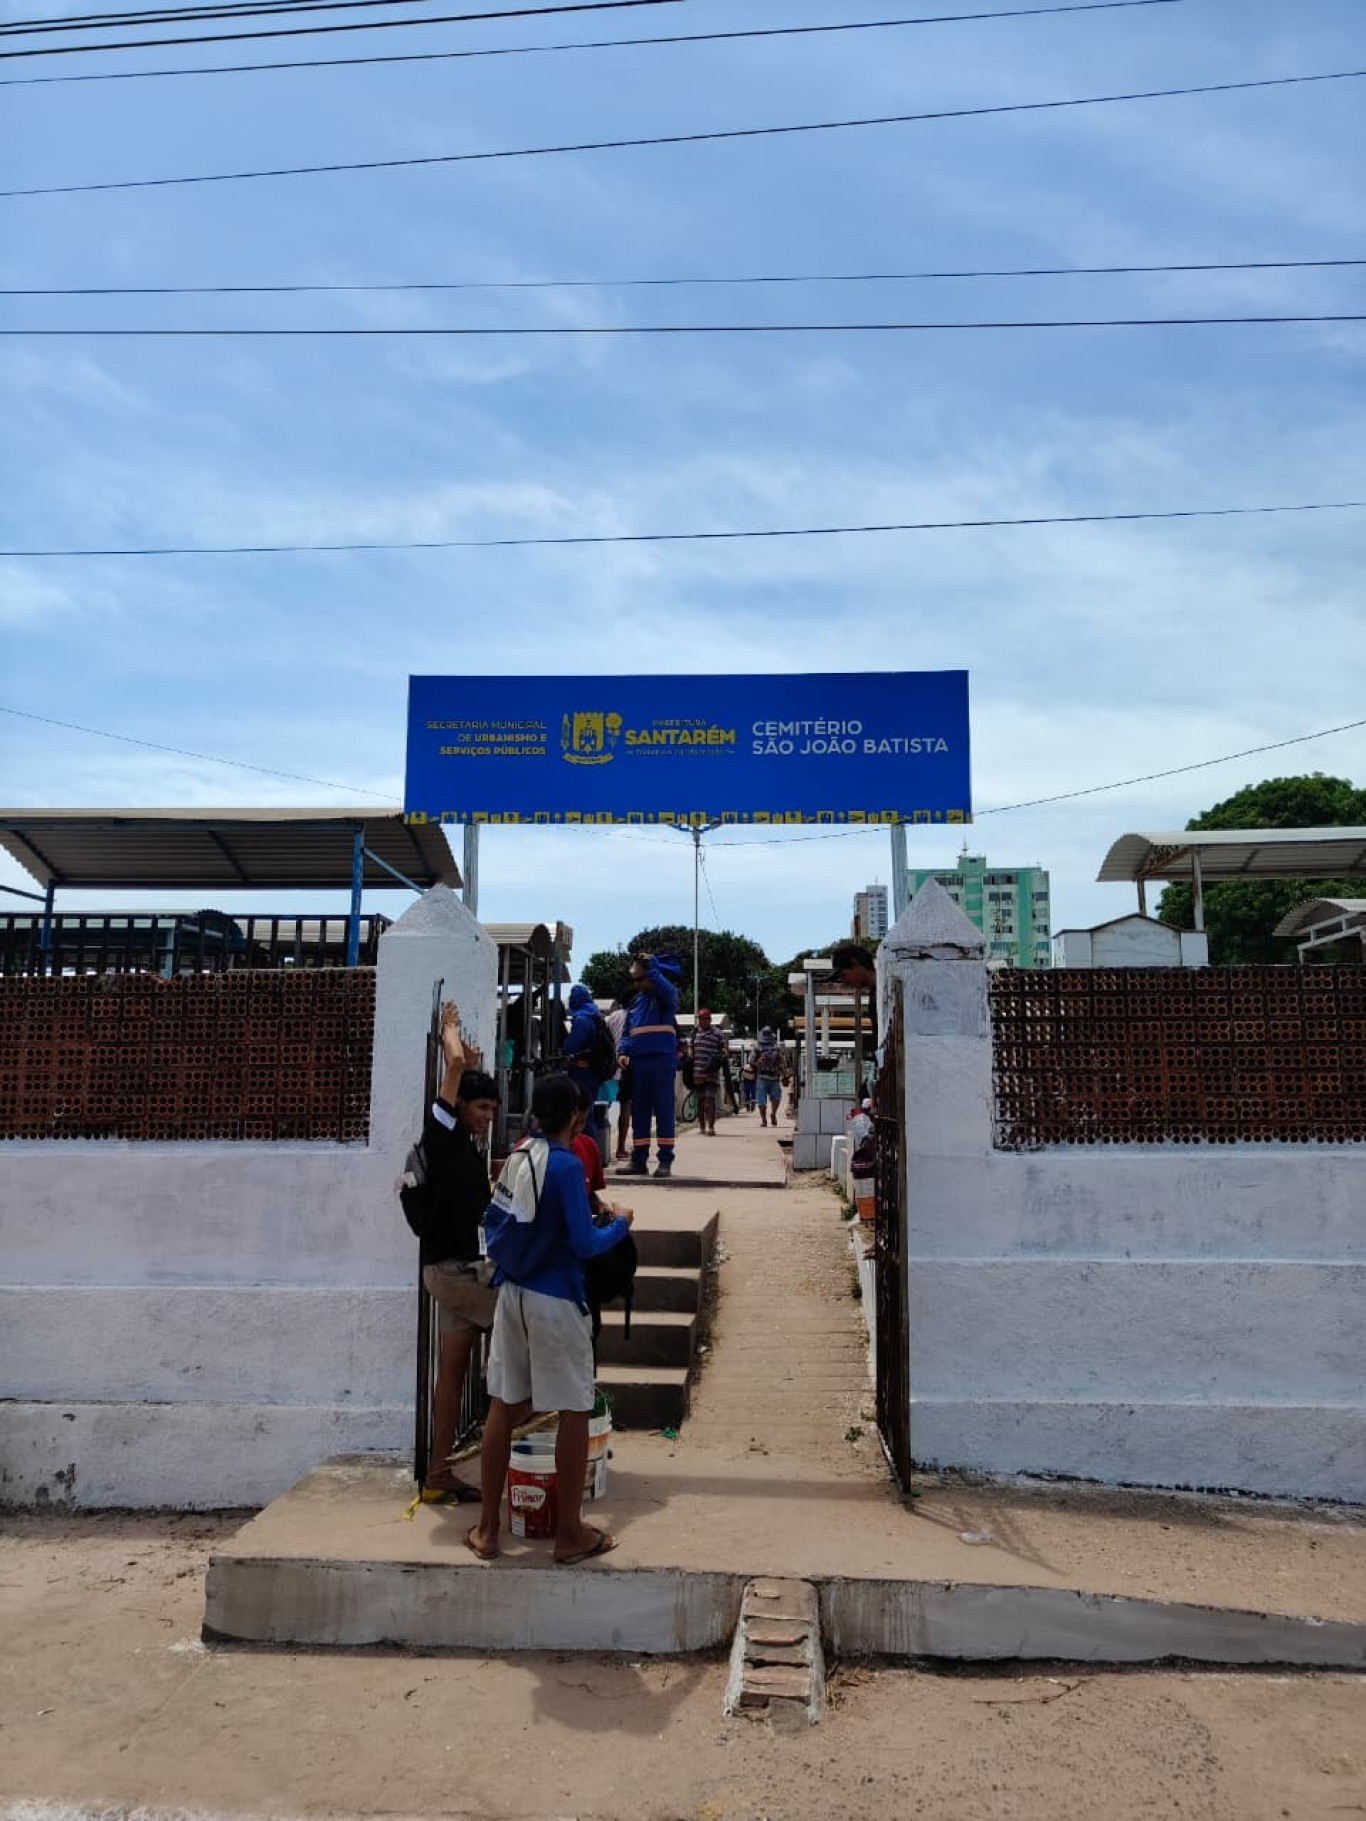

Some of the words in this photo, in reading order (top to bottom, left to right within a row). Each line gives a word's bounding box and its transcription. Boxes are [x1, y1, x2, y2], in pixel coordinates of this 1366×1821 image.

[625, 725, 735, 745] SANTARÉM
[752, 717, 863, 736] CEMITÉRIO
[475, 733, 537, 742] URBANISMO
[540, 733, 547, 742] E
[752, 736, 794, 755] SÃO
[800, 736, 857, 754] JOÃO
[863, 737, 949, 754] BATISTA
[440, 746, 491, 756] SERVIÇOS
[494, 744, 546, 755] PÚBLICOS
